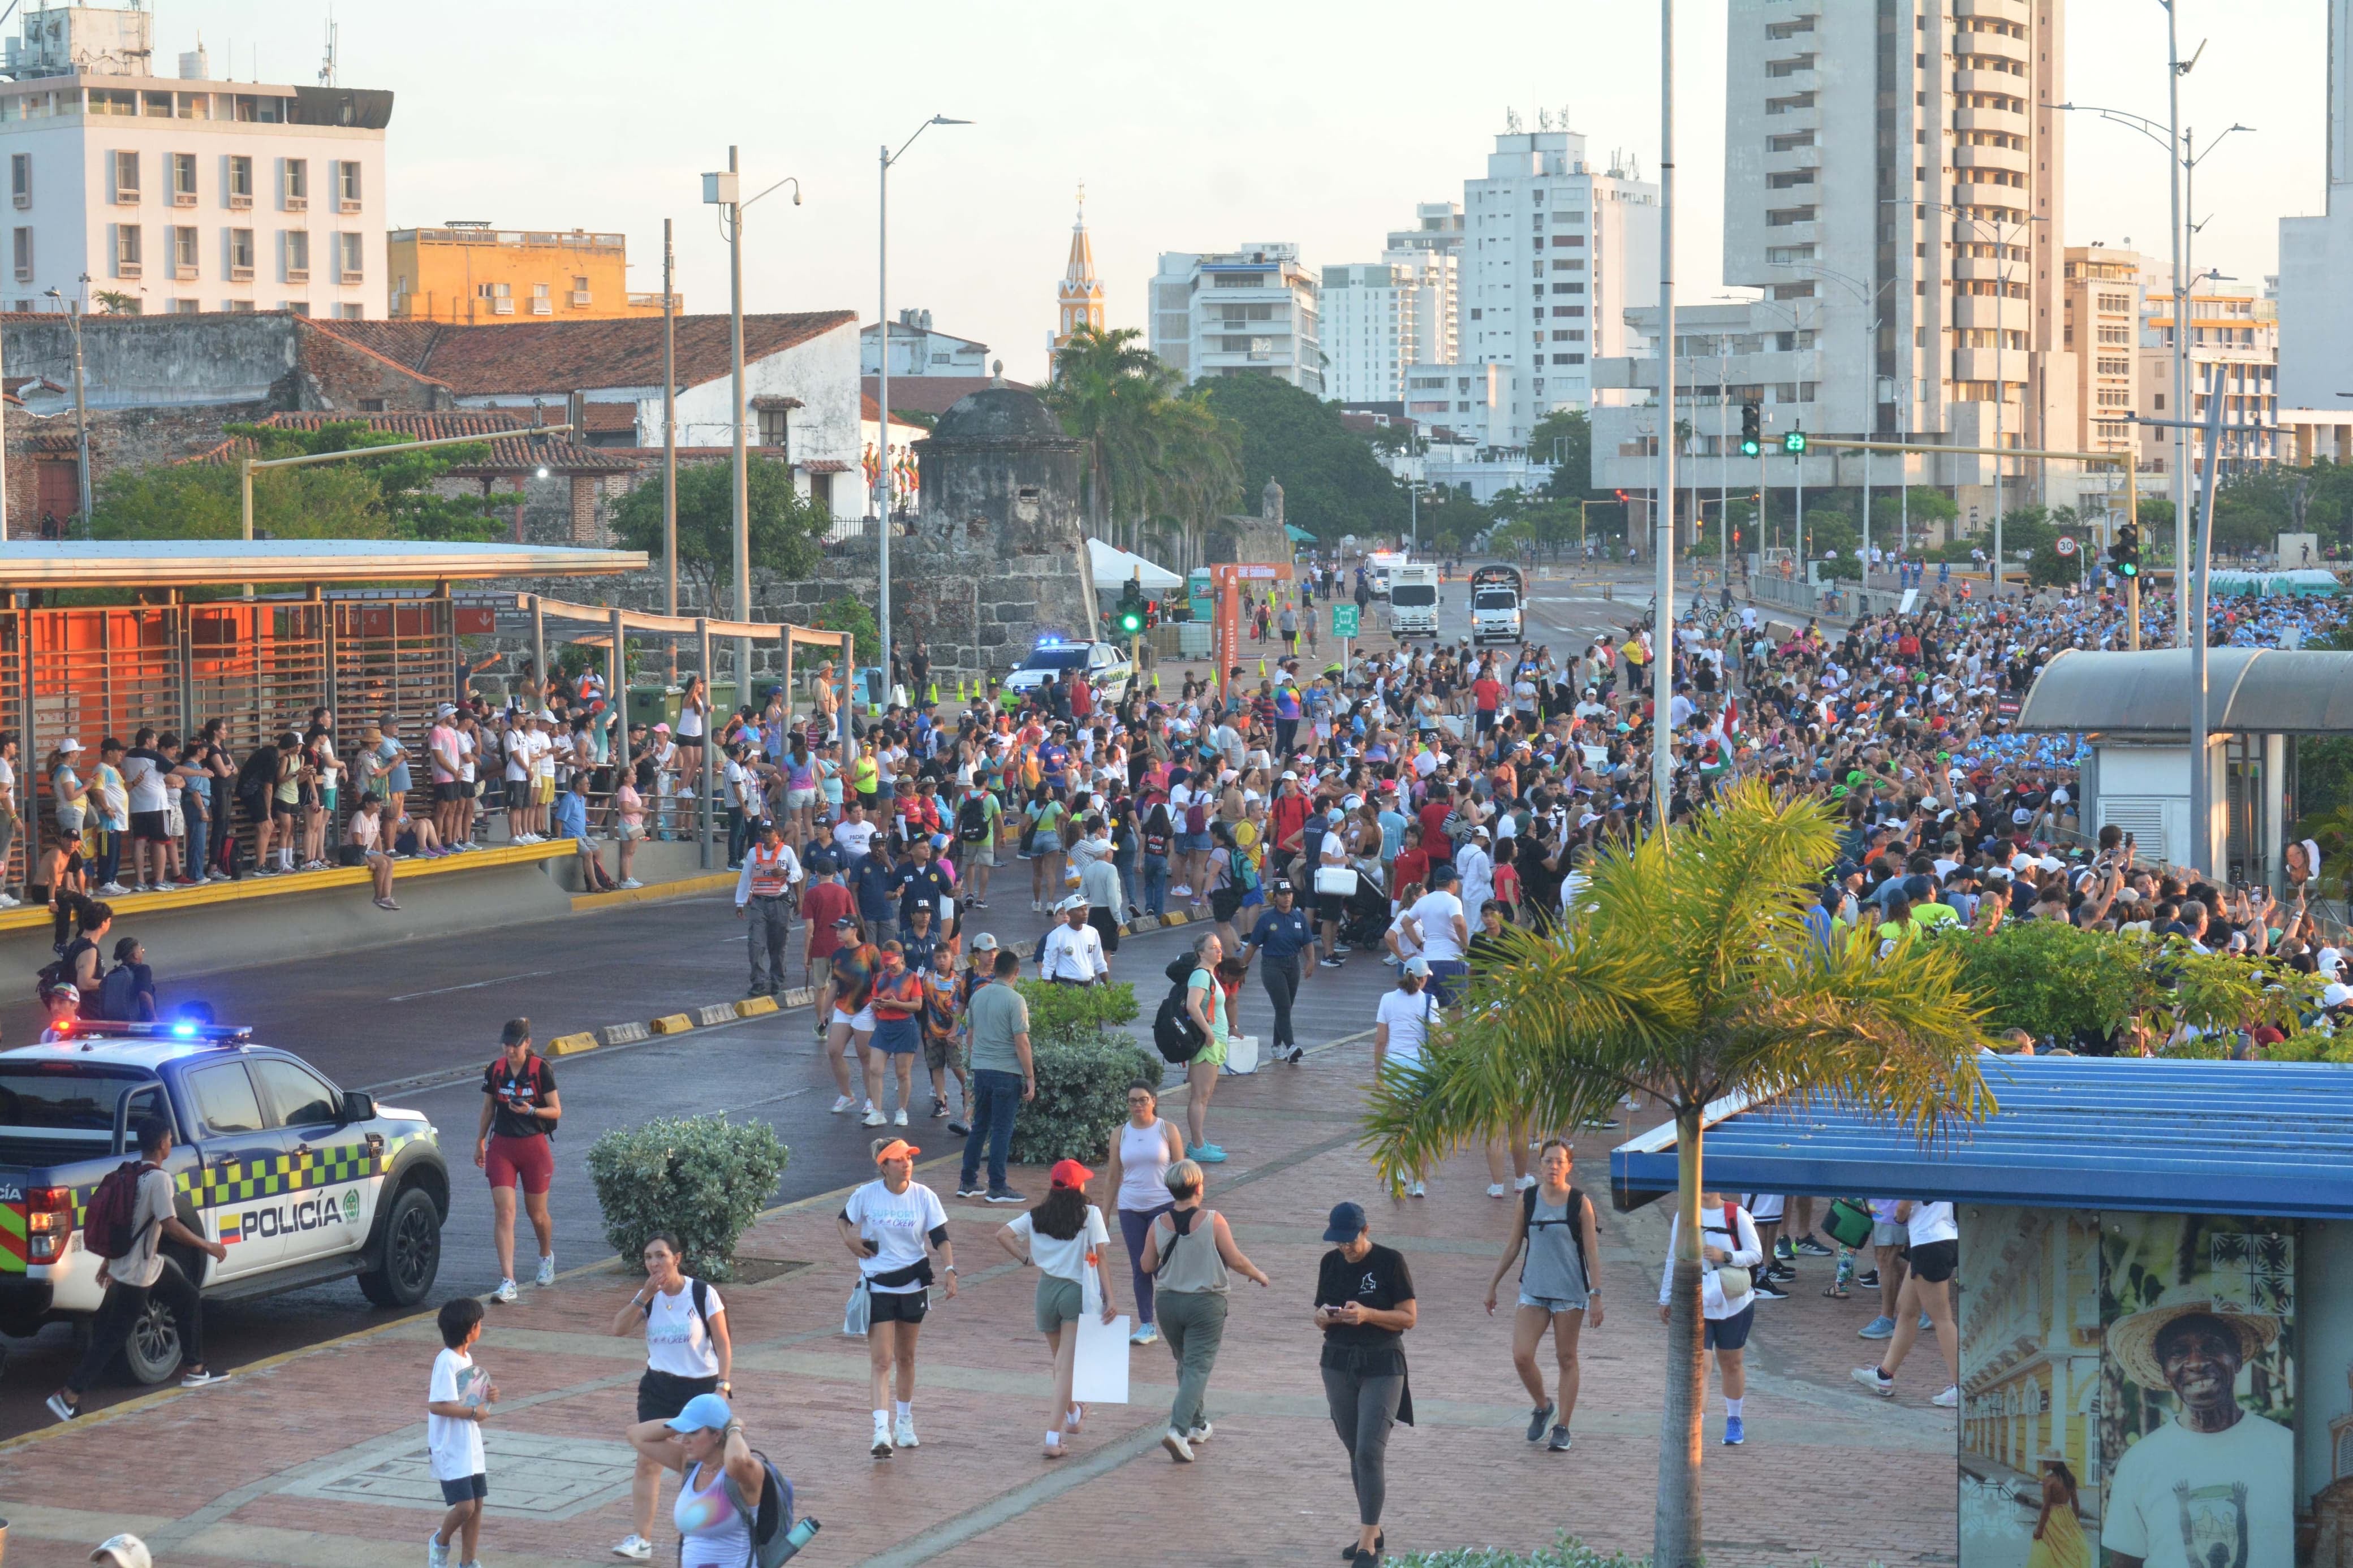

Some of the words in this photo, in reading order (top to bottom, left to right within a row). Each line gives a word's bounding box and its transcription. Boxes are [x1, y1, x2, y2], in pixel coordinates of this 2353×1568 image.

[1787, 434, 1804, 450] 23
[2060, 542, 2072, 550] 30
[242, 1188, 342, 1241] POLICÍA
[872, 1210, 915, 1218] SUPPORT
[893, 1219, 916, 1227] CREW
[668, 1334, 692, 1344] CREW
